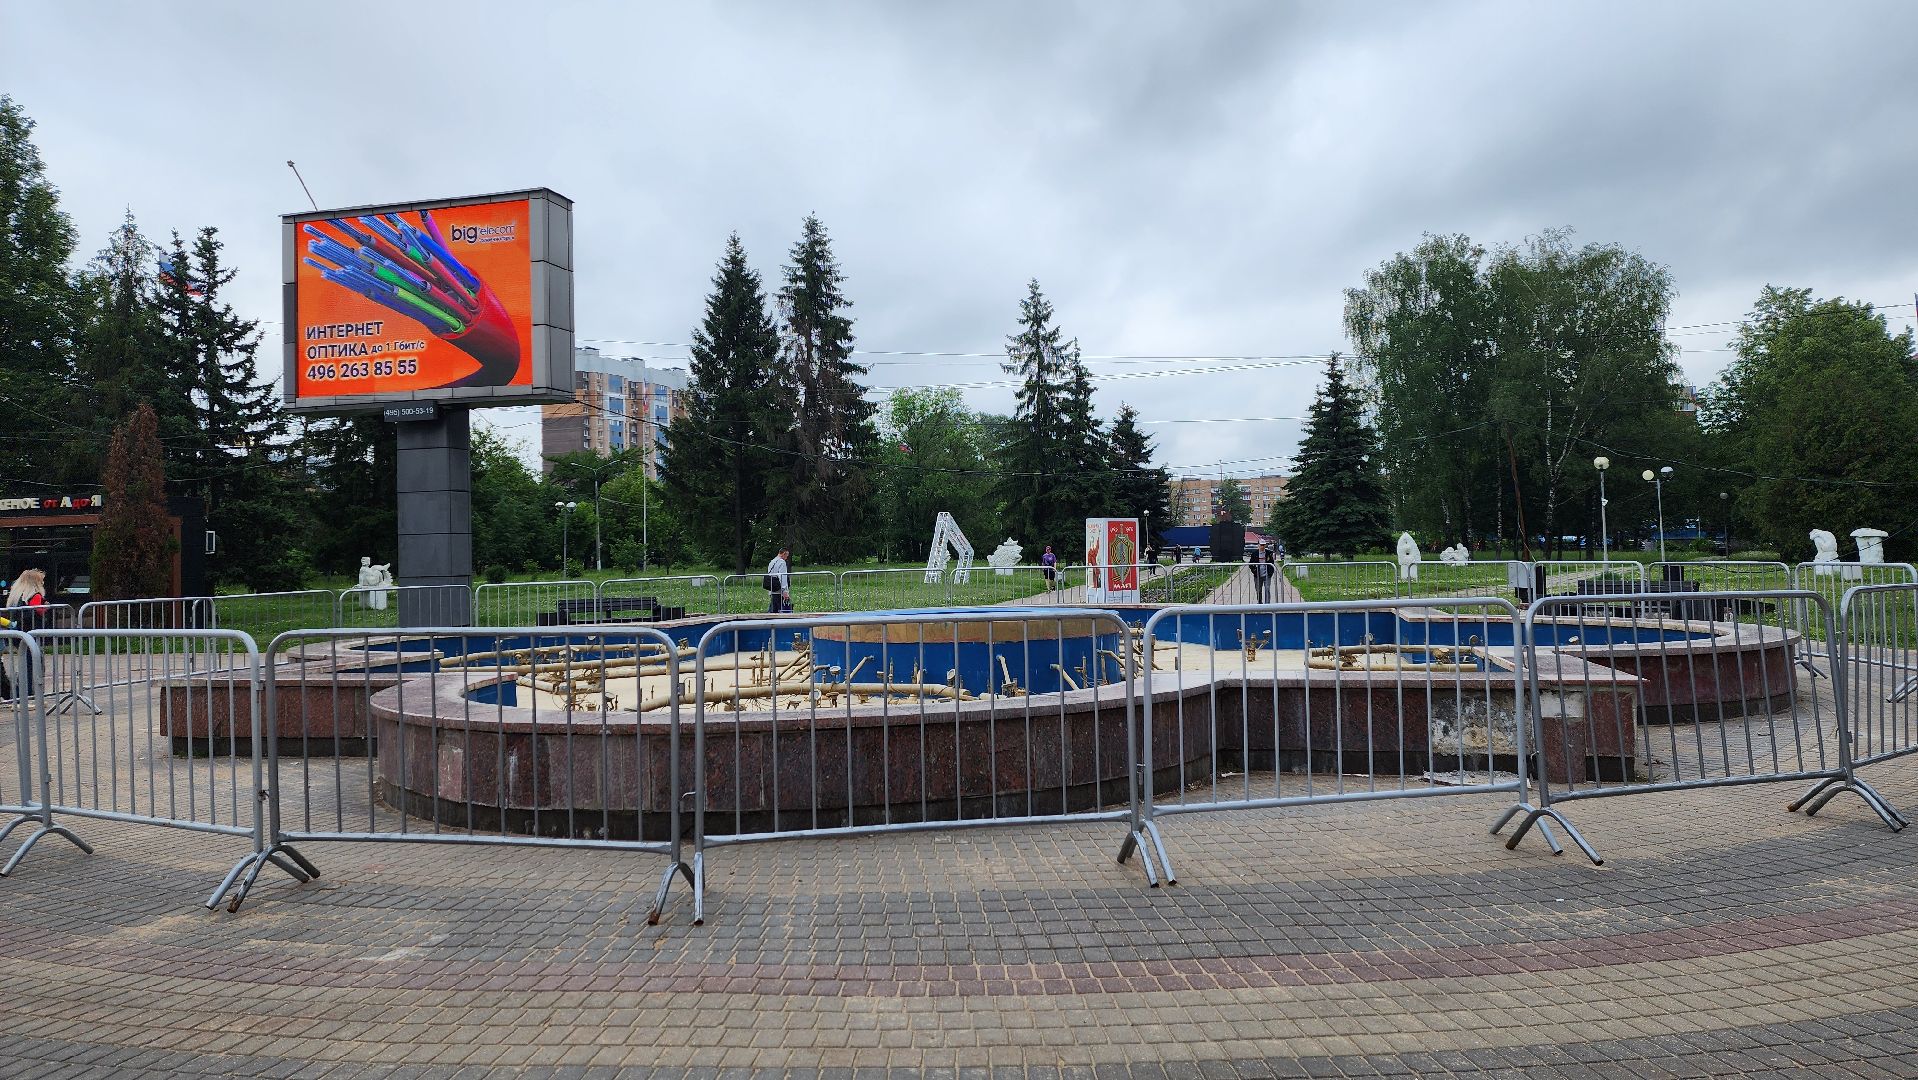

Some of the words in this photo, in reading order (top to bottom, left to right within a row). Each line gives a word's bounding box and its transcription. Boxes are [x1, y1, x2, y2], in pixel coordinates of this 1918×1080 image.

[451, 224, 478, 244] big
[478, 224, 515, 236] elecom
[306, 321, 384, 340] ИНТЕРНЕТ
[307, 342, 368, 360] ОПТИКА
[371, 345, 383, 354] до
[394, 340, 425, 351] Гбит/с
[307, 364, 336, 380] 496
[340, 362, 369, 378] 263
[373, 360, 393, 376] 85
[397, 358, 417, 375] 55
[401, 406, 434, 416] 500-53-19
[60, 496, 73, 508] А
[91, 494, 102, 507] Я
